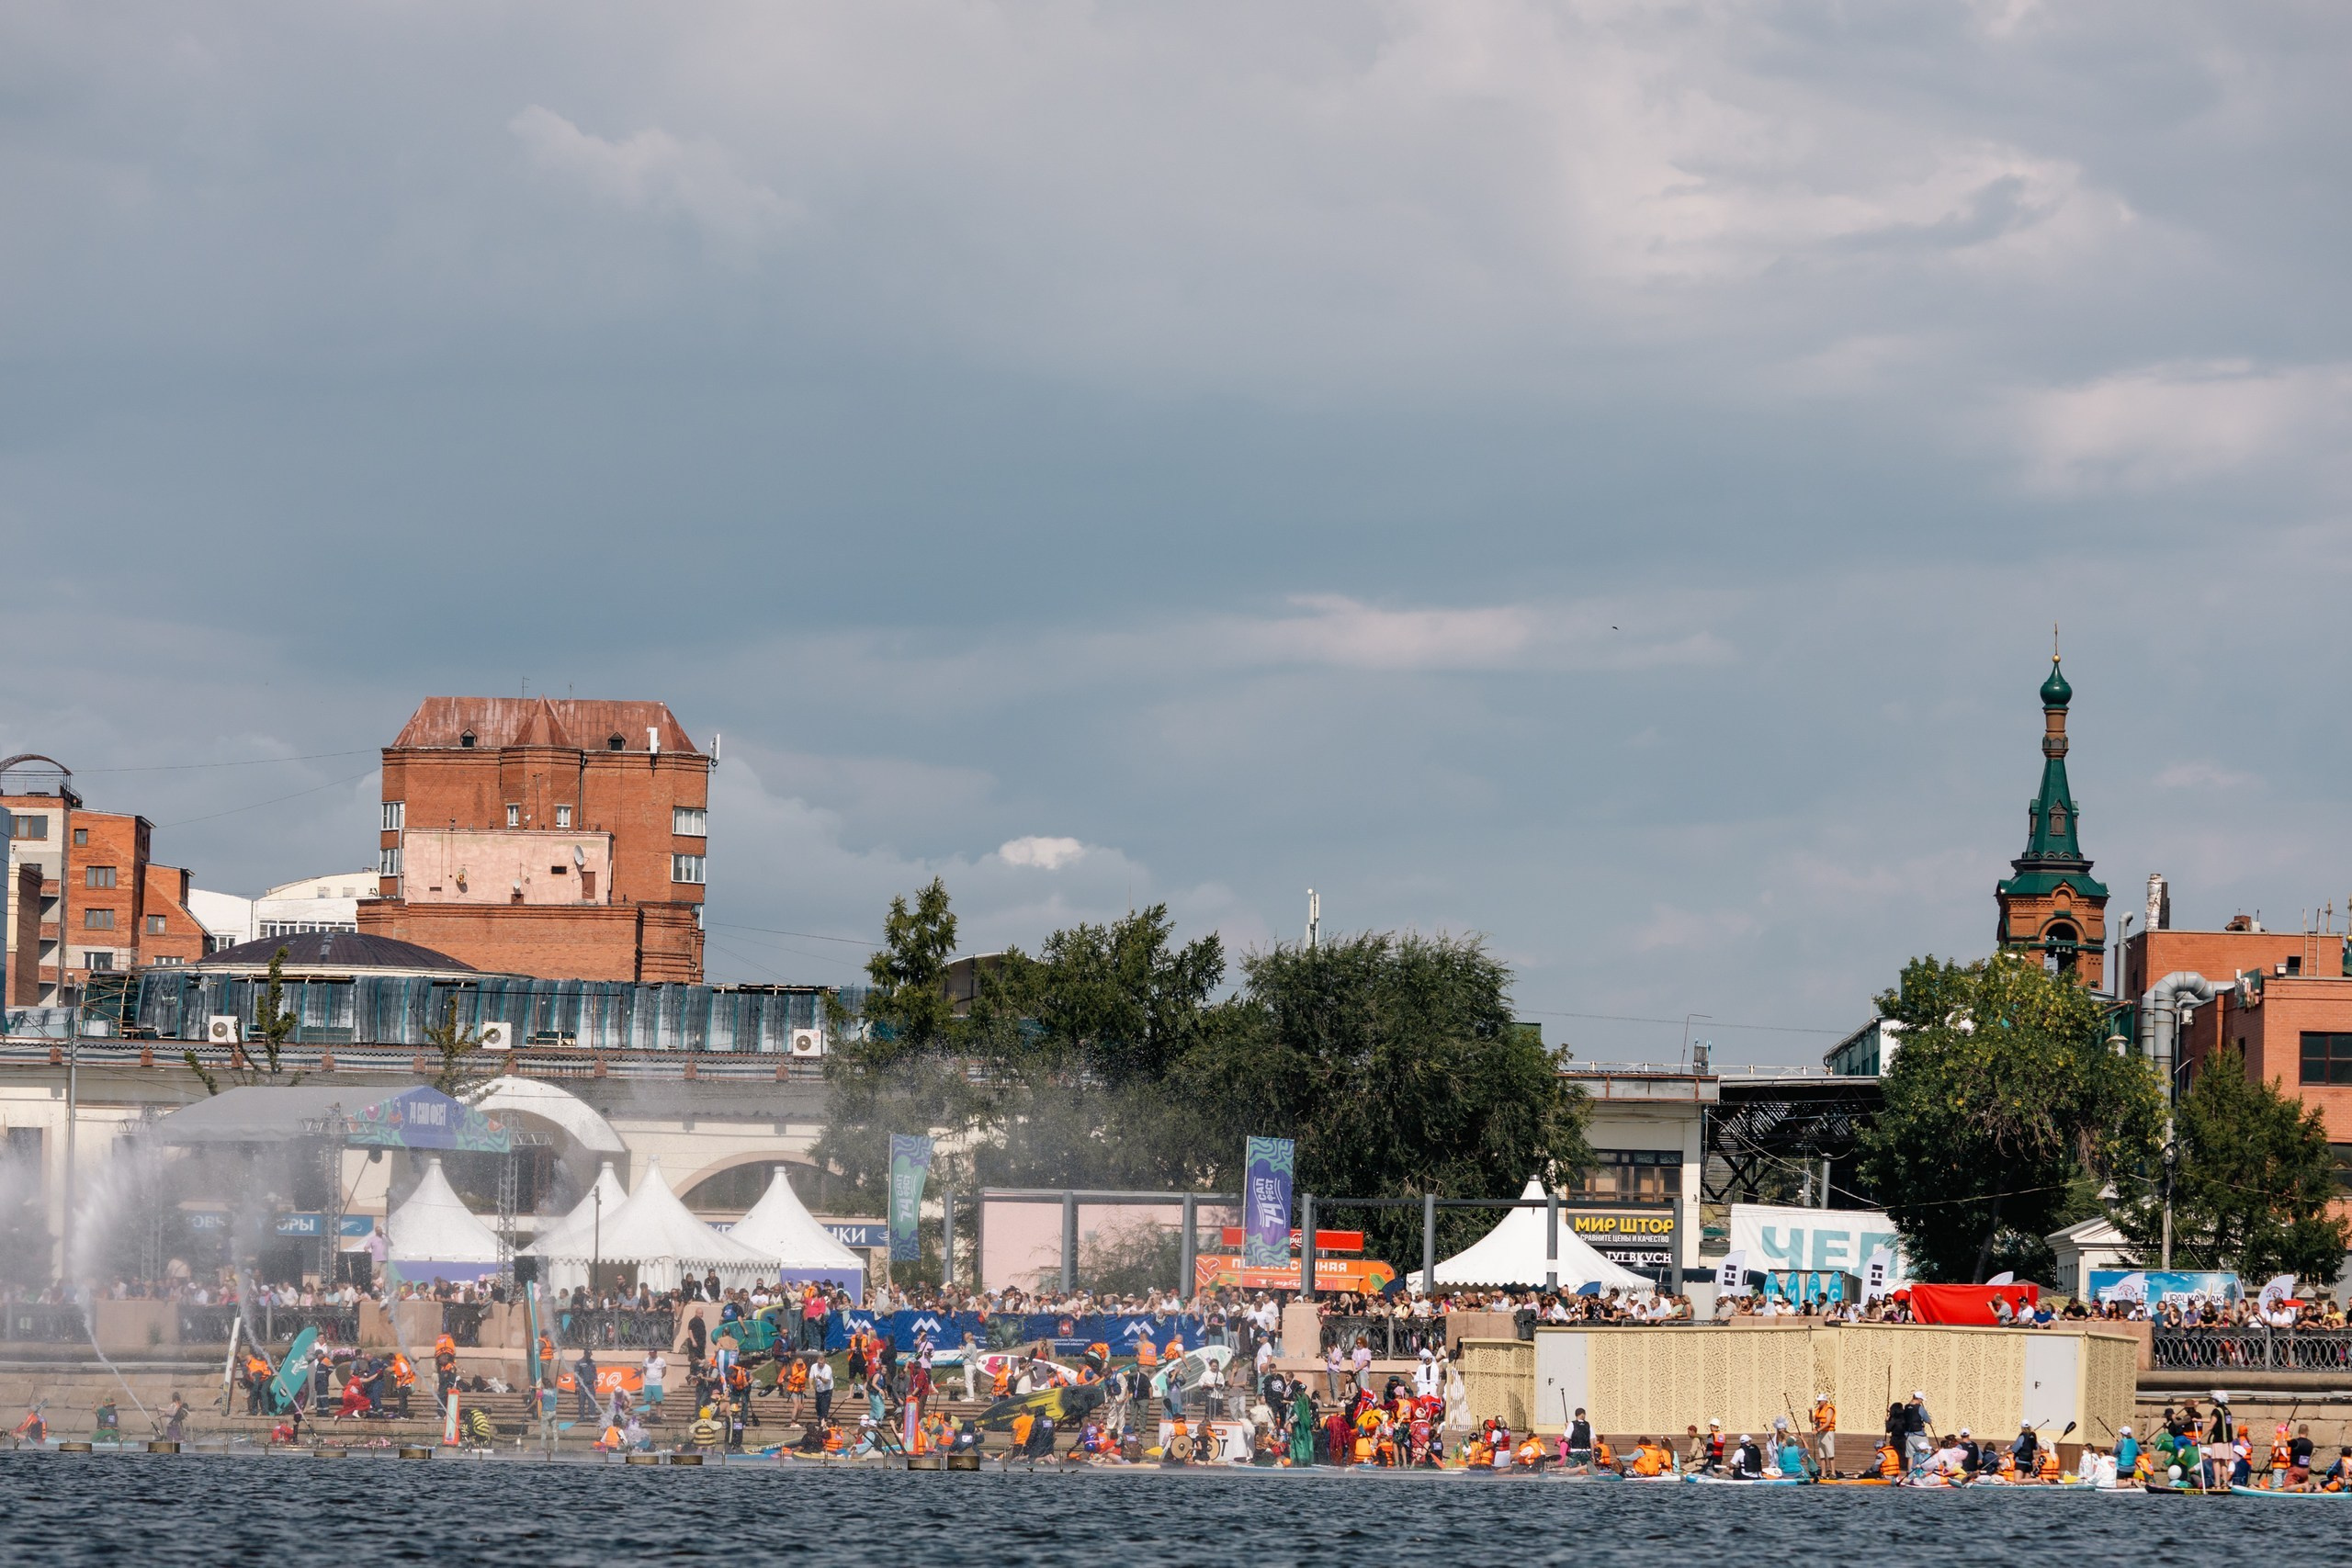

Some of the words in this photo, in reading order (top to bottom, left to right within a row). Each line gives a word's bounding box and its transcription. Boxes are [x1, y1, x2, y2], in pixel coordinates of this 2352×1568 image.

[1256, 1178, 1266, 1201] САП
[1265, 1179, 1275, 1201] ФЕСТ
[899, 1198, 914, 1223] 74
[1263, 1202, 1284, 1228] 74
[1575, 1216, 1617, 1233] МИР
[1620, 1217, 1674, 1234] ШТОР
[1580, 1234, 1611, 1242] СРАВНИТЕ
[1612, 1235, 1632, 1243] ЦЕНЫ
[1637, 1235, 1669, 1243] КАЧЕСТВО
[1606, 1251, 1627, 1262] ТУТ
[1629, 1251, 1673, 1264] ВКУСН
